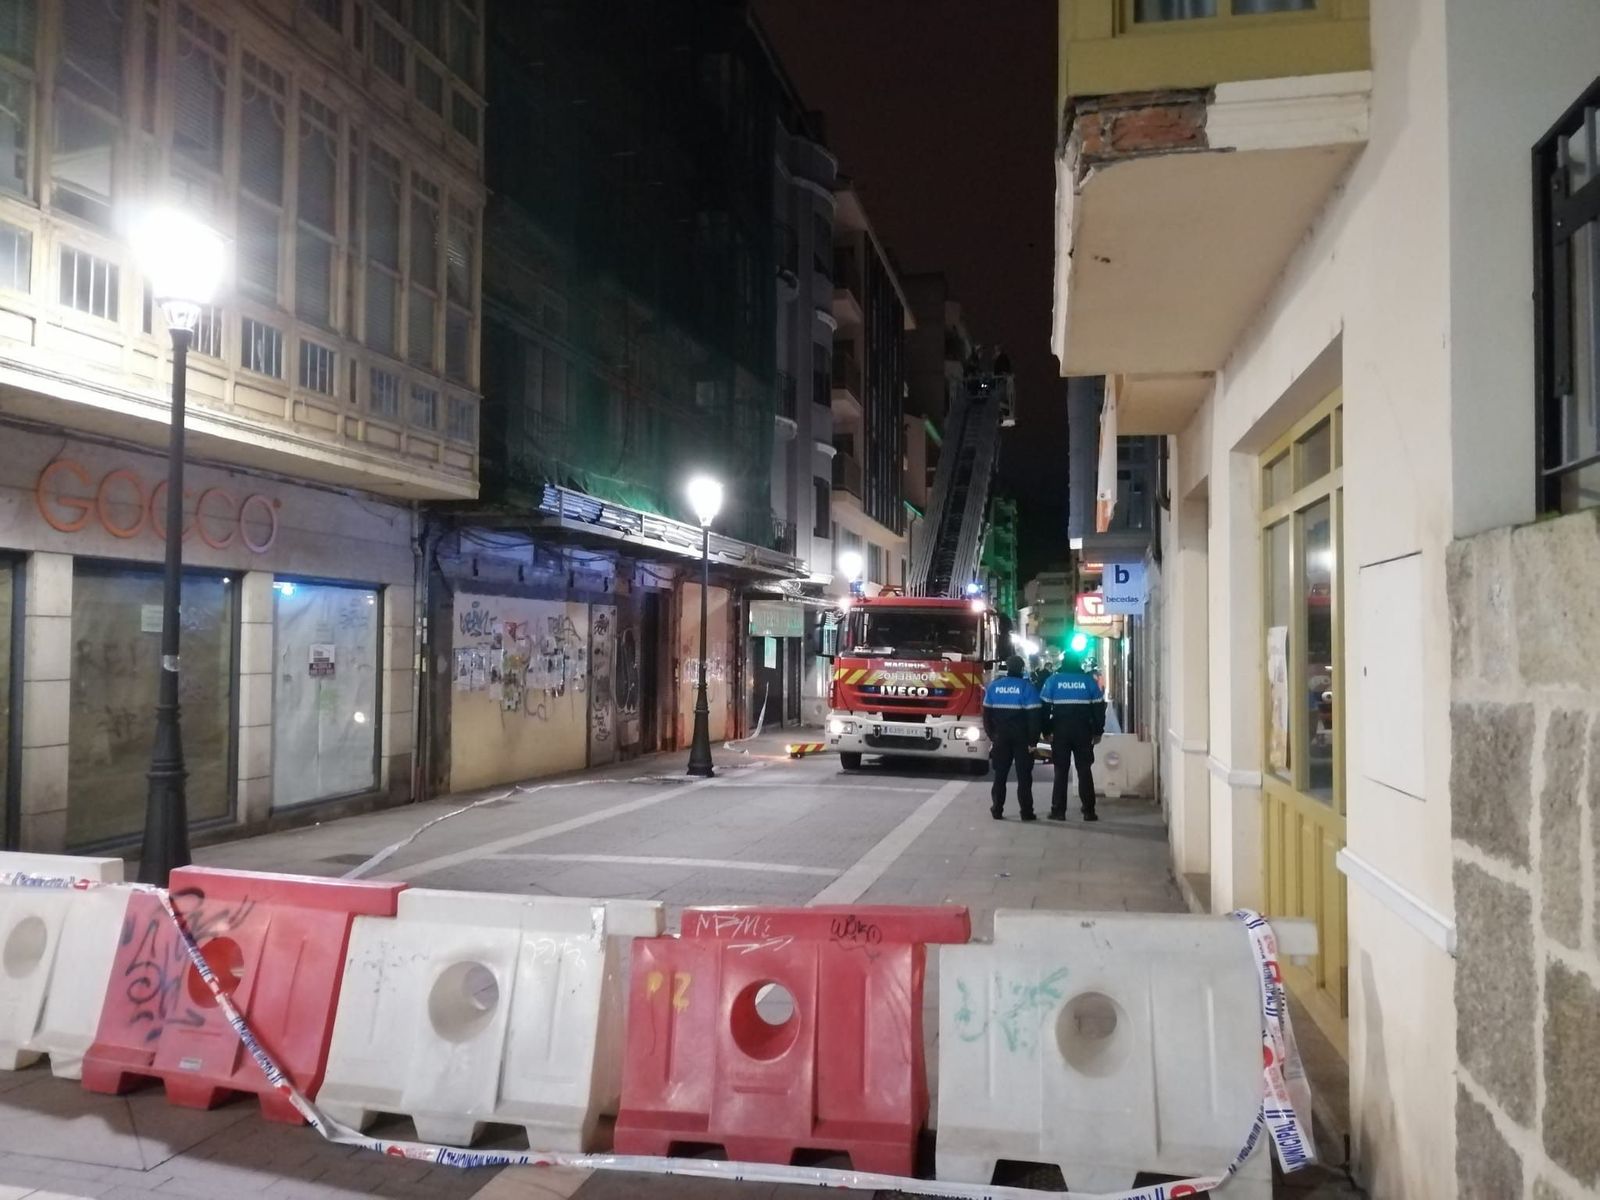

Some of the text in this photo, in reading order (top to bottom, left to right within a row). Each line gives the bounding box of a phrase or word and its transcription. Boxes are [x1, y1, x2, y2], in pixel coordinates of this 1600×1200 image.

[36, 459, 278, 553] GOCCO
[1114, 564, 1130, 584] b
[880, 685, 929, 697] IVECO
[995, 686, 1020, 695] POLICÍA
[1057, 681, 1087, 690] POLICÍA
